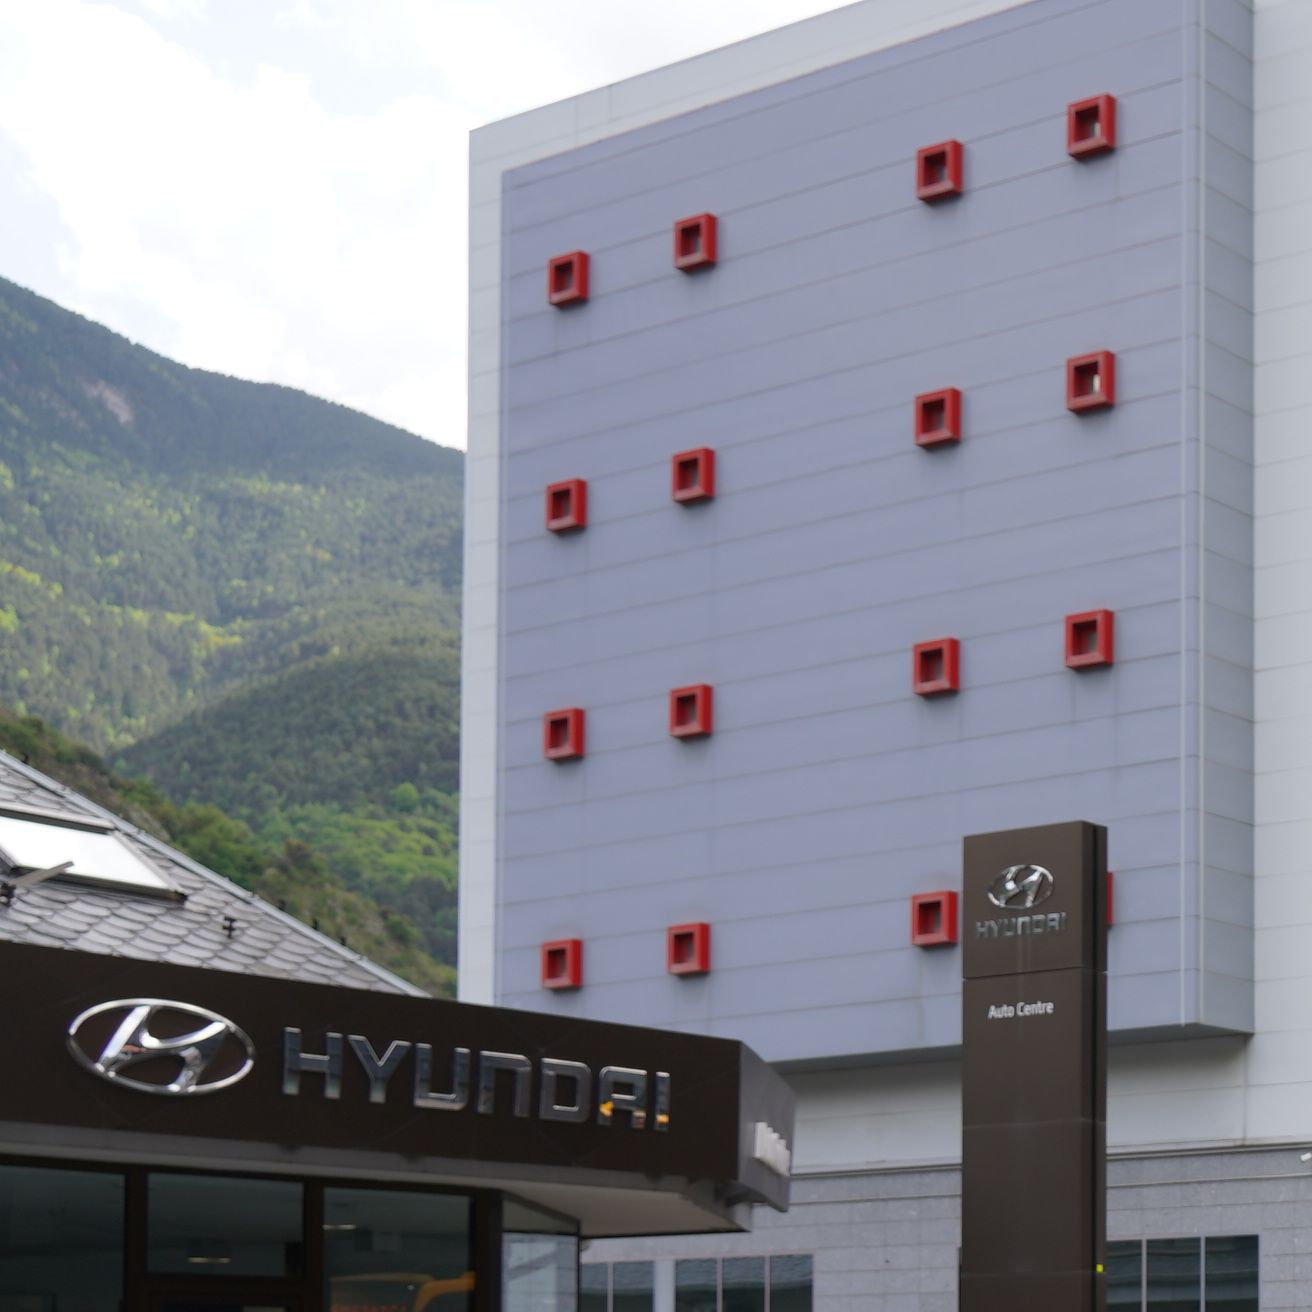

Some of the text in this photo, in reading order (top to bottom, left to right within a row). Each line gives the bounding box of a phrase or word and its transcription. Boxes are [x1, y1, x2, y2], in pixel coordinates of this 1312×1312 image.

[975, 912, 1067, 939] HYUNDAI
[988, 1001, 1054, 1019] Auto Centre
[282, 1026, 671, 1132] HYUNDAI
